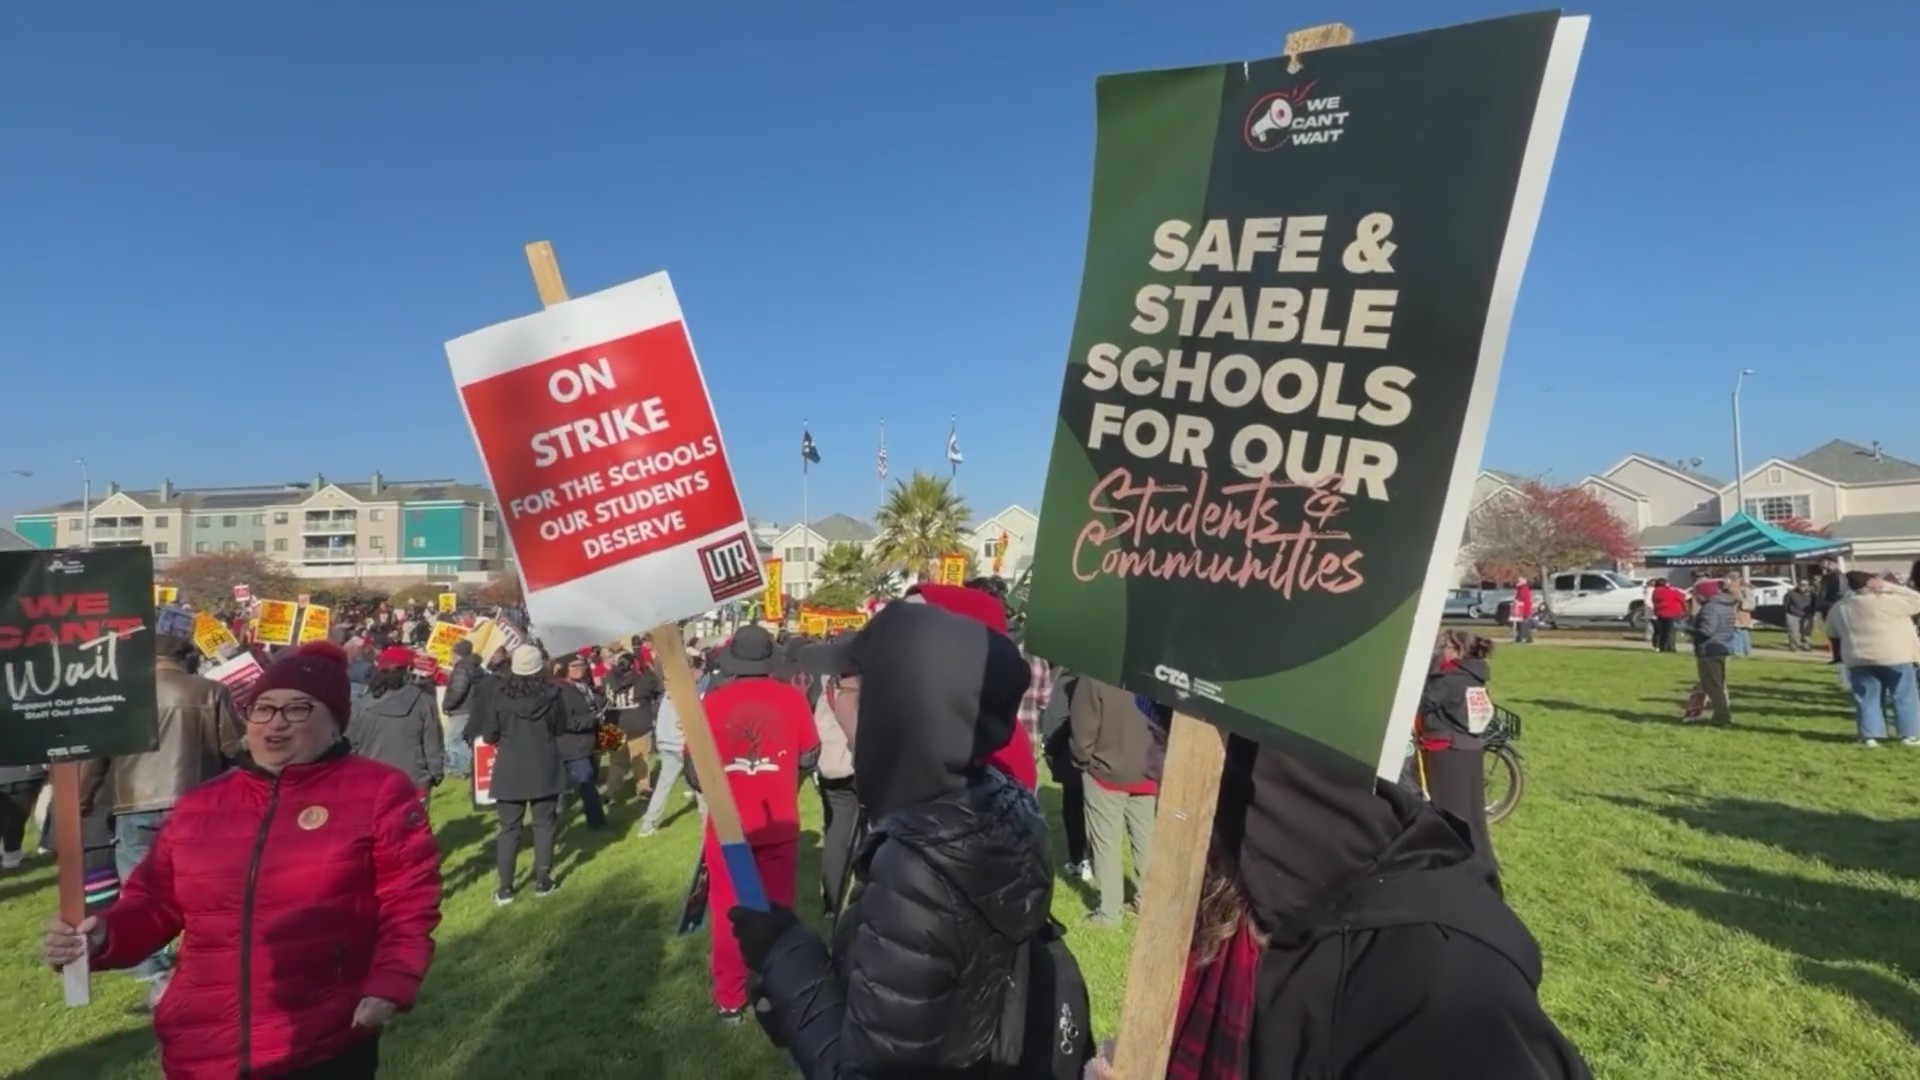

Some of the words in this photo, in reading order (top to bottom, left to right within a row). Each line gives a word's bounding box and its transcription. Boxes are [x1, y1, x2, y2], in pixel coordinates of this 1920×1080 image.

[1306, 95, 1341, 112] WE
[1291, 128, 1344, 146] WAIT
[1148, 215, 1328, 272] SAFE
[1342, 212, 1398, 274] &
[1129, 284, 1399, 349] STABLE
[548, 356, 617, 404] ON
[1082, 342, 1417, 427] SCHOOLS
[531, 396, 670, 468] STRIKE
[1087, 402, 1215, 468] FOR
[1230, 424, 1399, 501] OUR
[510, 488, 560, 519] FOR
[559, 472, 605, 502] THE
[608, 435, 718, 487] SCHOOLS
[539, 509, 593, 541] OUR
[594, 470, 710, 523] STUDENTS
[1088, 466, 1300, 547] Students
[1303, 473, 1350, 528] &
[582, 510, 687, 560] DESERVE
[705, 539, 754, 582] UTR
[1072, 520, 1365, 601] Communities
[1666, 554, 1766, 565] PROVIDENTCU.ORG
[18, 592, 111, 619] WE
[5, 624, 147, 701] Wait
[1154, 664, 1190, 690] CTA
[12, 700, 53, 711] Support
[54, 698, 75, 708] Our
[24, 710, 49, 720] Staff
[51, 708, 71, 718] Our
[72, 704, 114, 716] Schools
